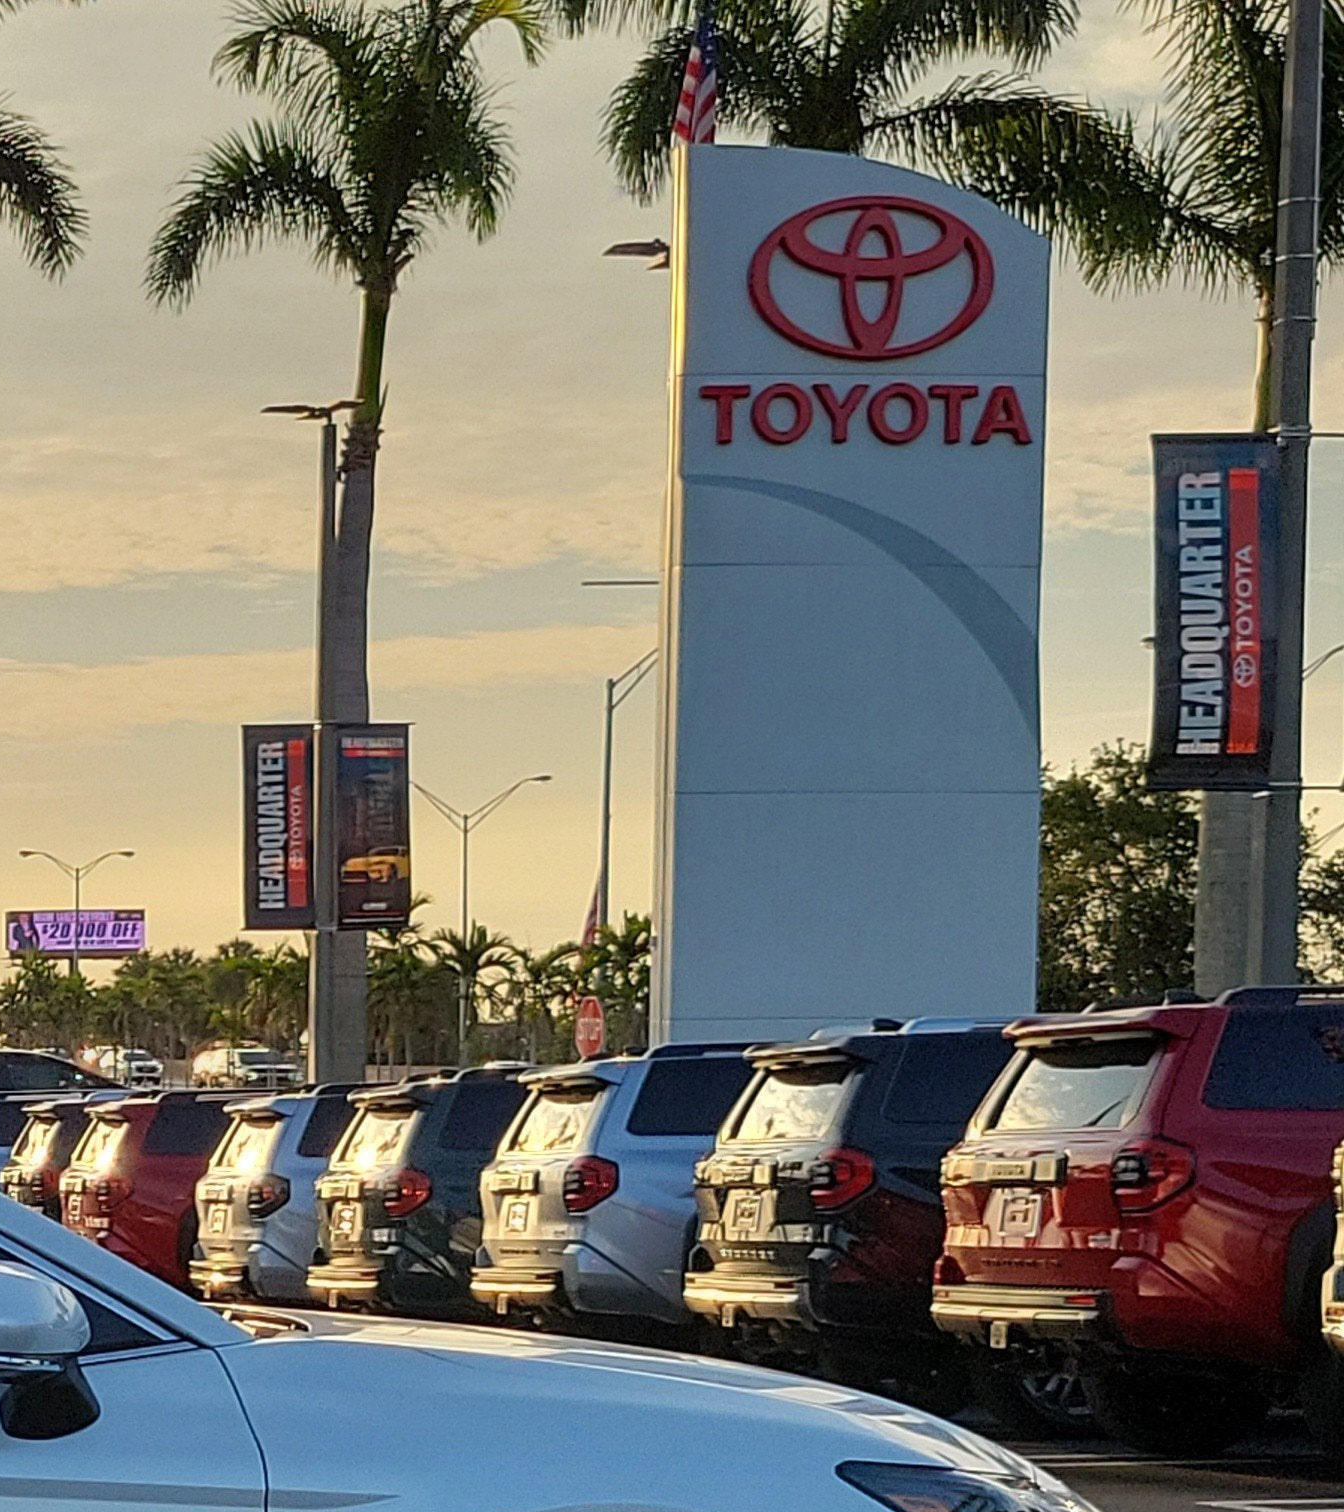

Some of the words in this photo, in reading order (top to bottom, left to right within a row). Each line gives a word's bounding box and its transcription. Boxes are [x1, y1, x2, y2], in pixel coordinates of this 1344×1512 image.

[698, 382, 1033, 445] TOYOTA
[1175, 471, 1230, 755] HEADQUARTER
[1234, 544, 1254, 651] TOYOTA
[256, 741, 288, 909] HEADQUARTER
[289, 785, 303, 849] TOYOTA
[111, 922, 138, 938] OFF
